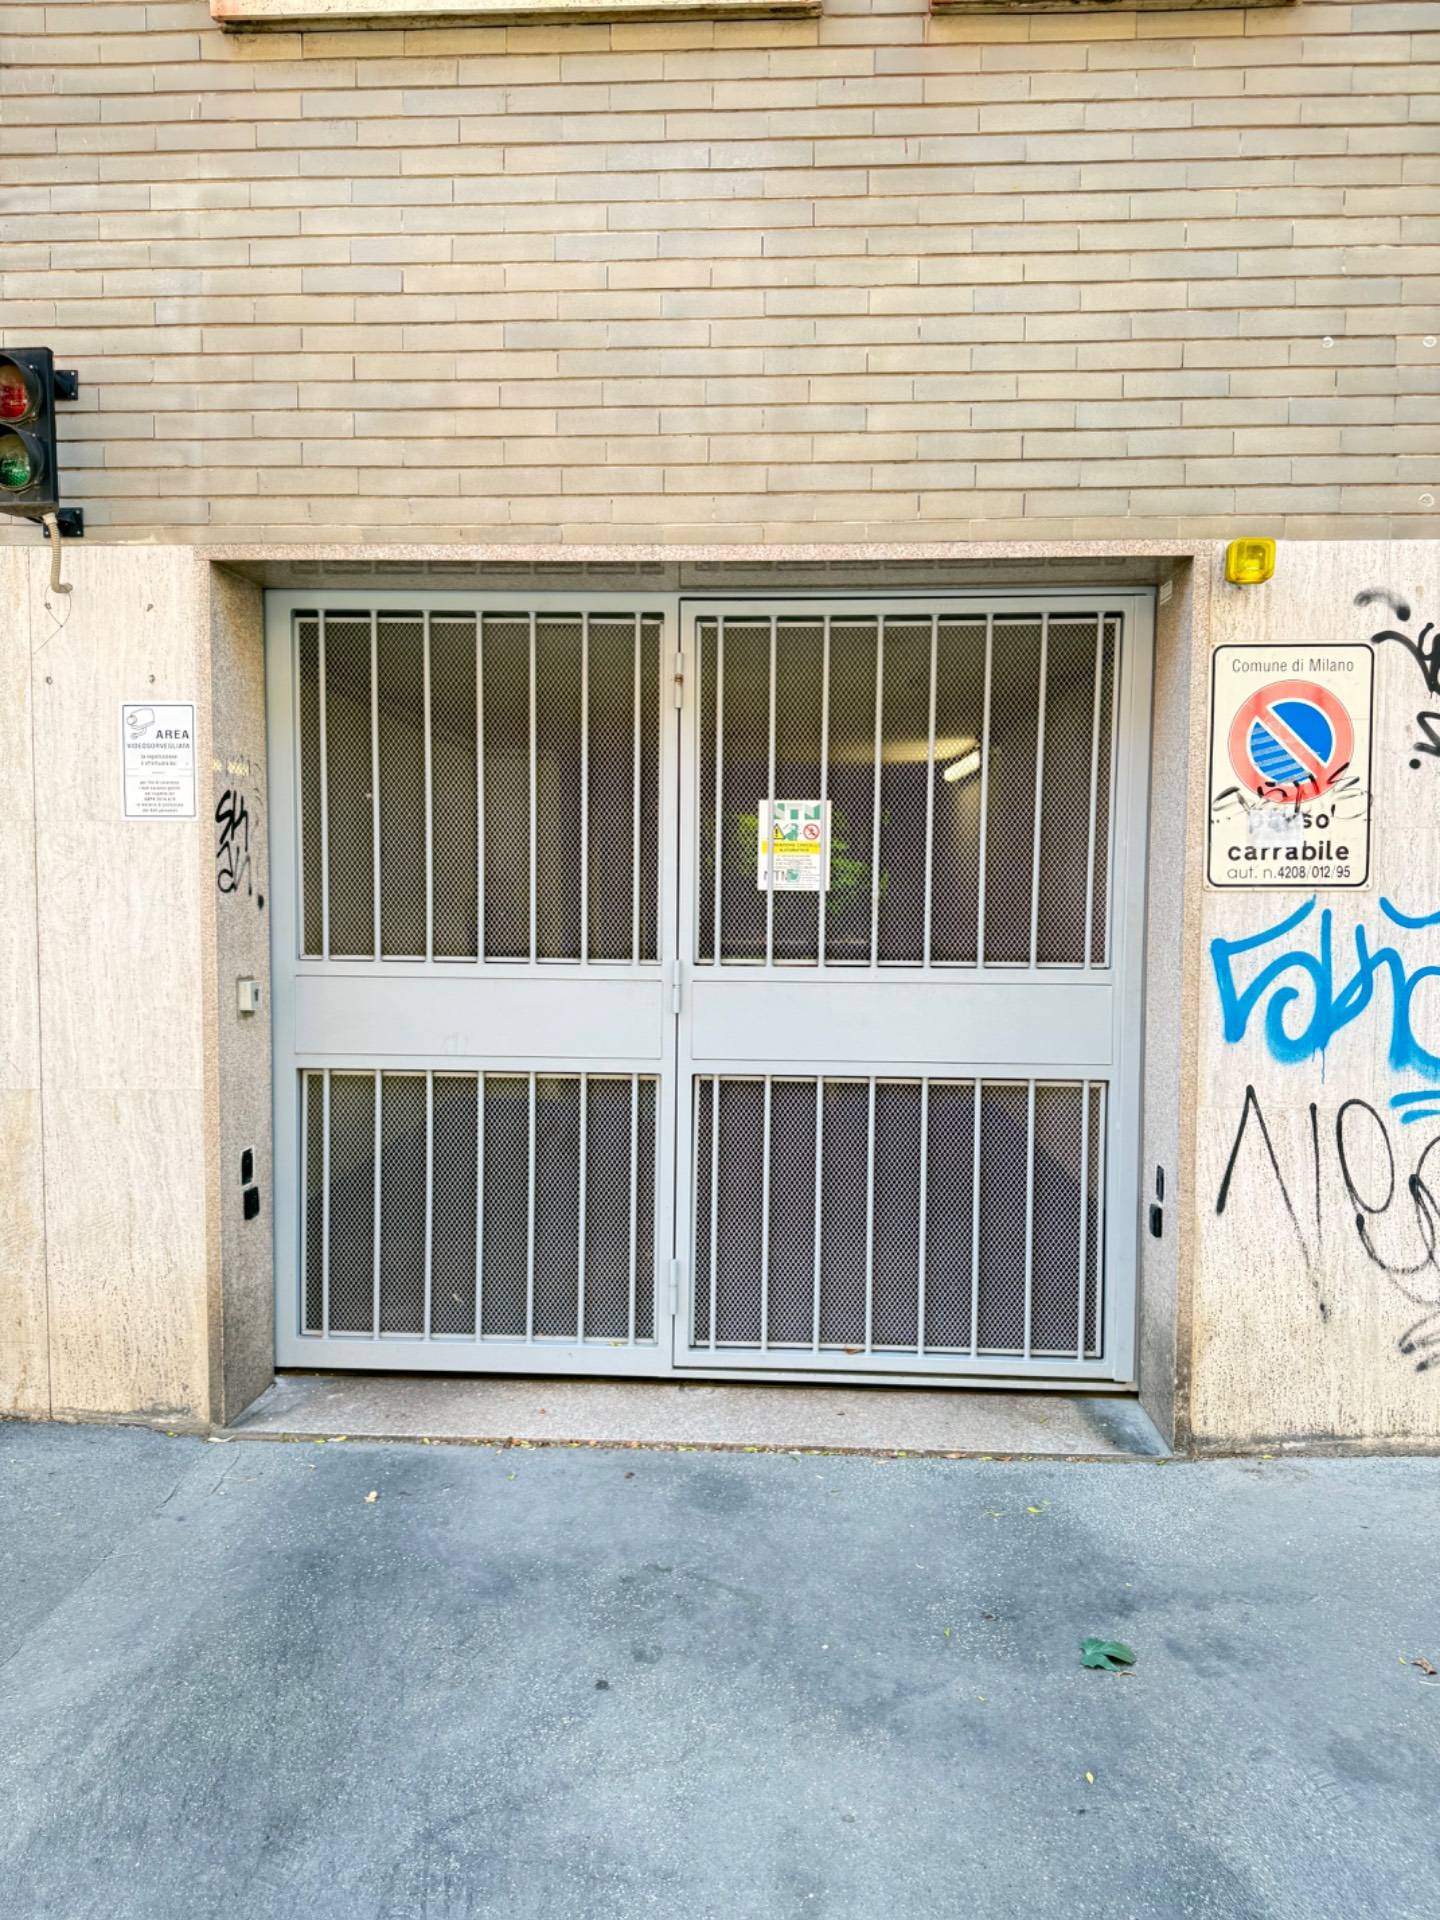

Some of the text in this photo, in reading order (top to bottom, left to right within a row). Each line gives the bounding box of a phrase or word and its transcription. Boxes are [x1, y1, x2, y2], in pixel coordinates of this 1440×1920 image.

[1232, 658, 1355, 673] Comune di Milano
[155, 729, 190, 740] AREA
[1227, 840, 1350, 861] carrabile
[1226, 866, 1258, 880] aut.
